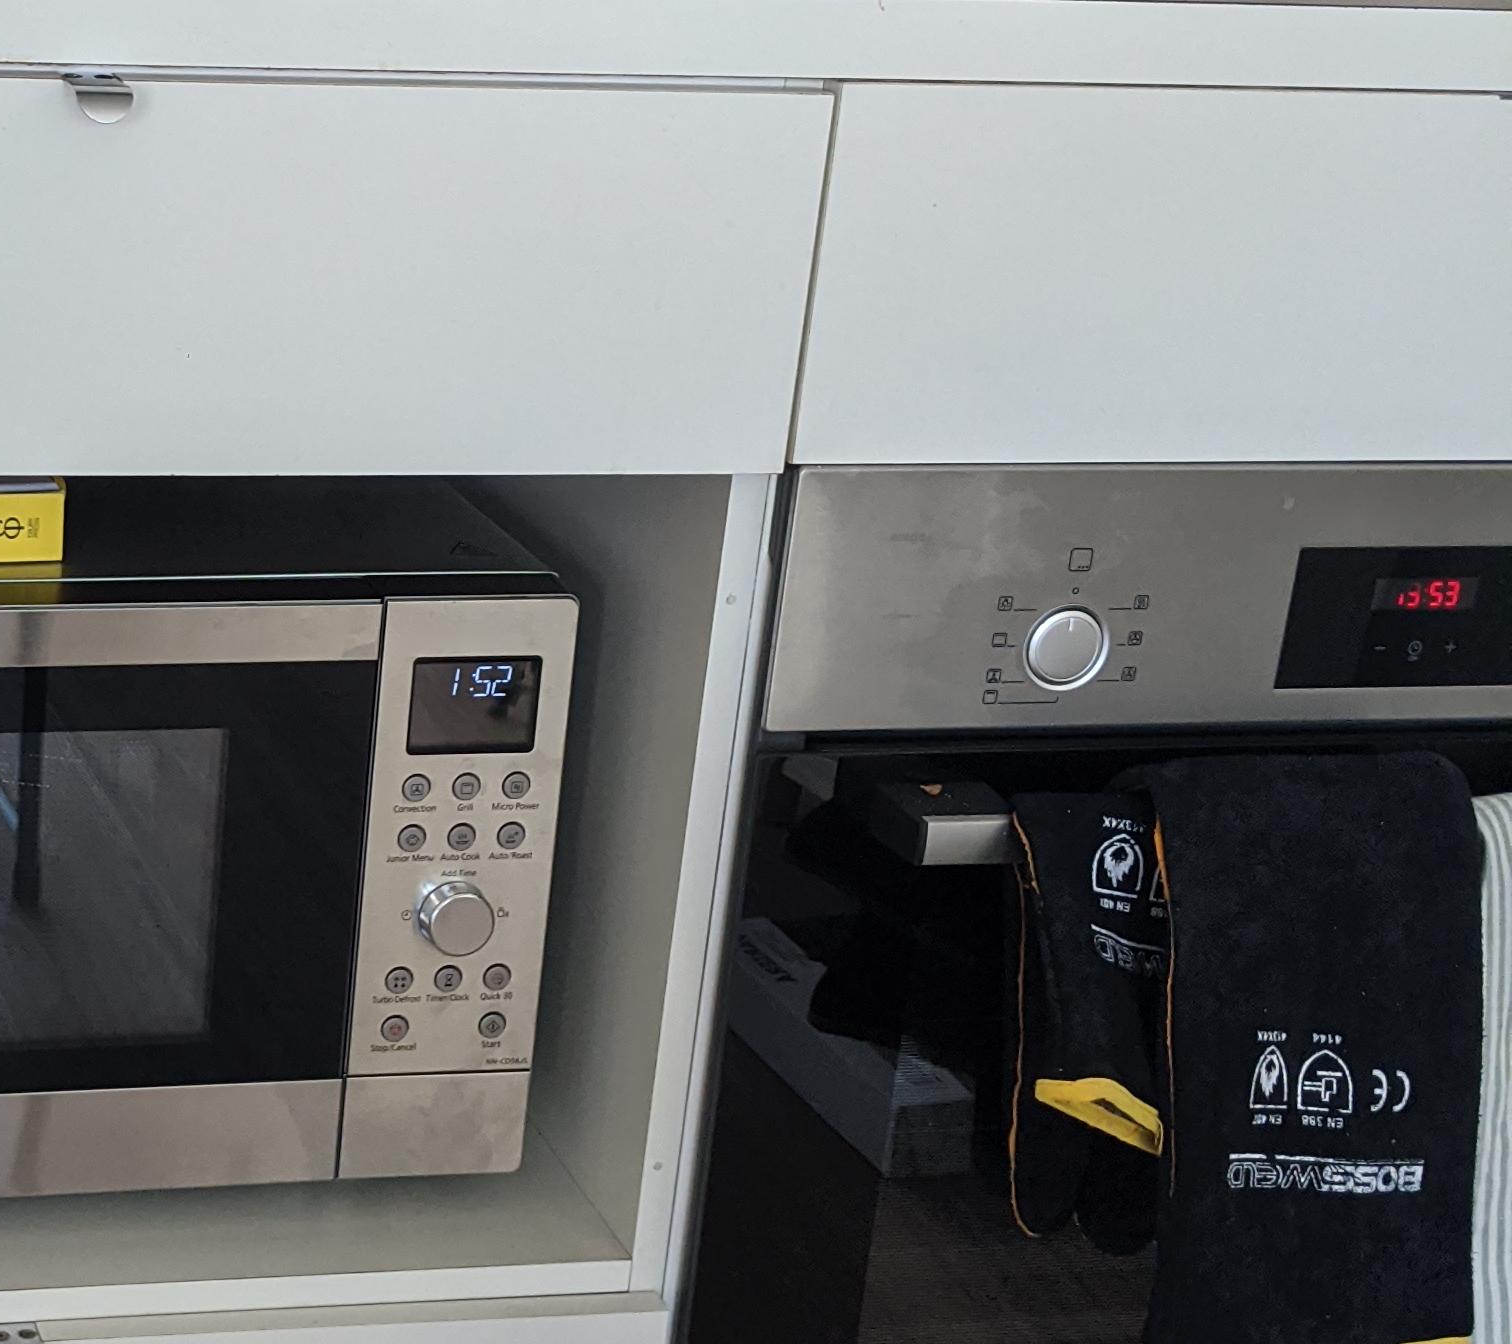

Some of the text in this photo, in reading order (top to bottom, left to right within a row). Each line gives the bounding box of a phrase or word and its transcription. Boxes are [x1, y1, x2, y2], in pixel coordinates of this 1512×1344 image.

[451, 665, 513, 697] 1:52
[456, 803, 475, 812] Grill
[491, 802, 540, 811] Micro Power
[412, 854, 435, 863] Menu
[439, 852, 481, 861] Auto Cook
[488, 852, 508, 860] Auto
[1116, 900, 1131, 913] EN
[480, 992, 501, 1001] Quick
[1312, 1032, 1343, 1045] 4144
[481, 1040, 502, 1049] Start
[1268, 1114, 1283, 1125] EN
[1327, 1117, 1344, 1129] EN
[1226, 1160, 1424, 1194] BOSSWELD
